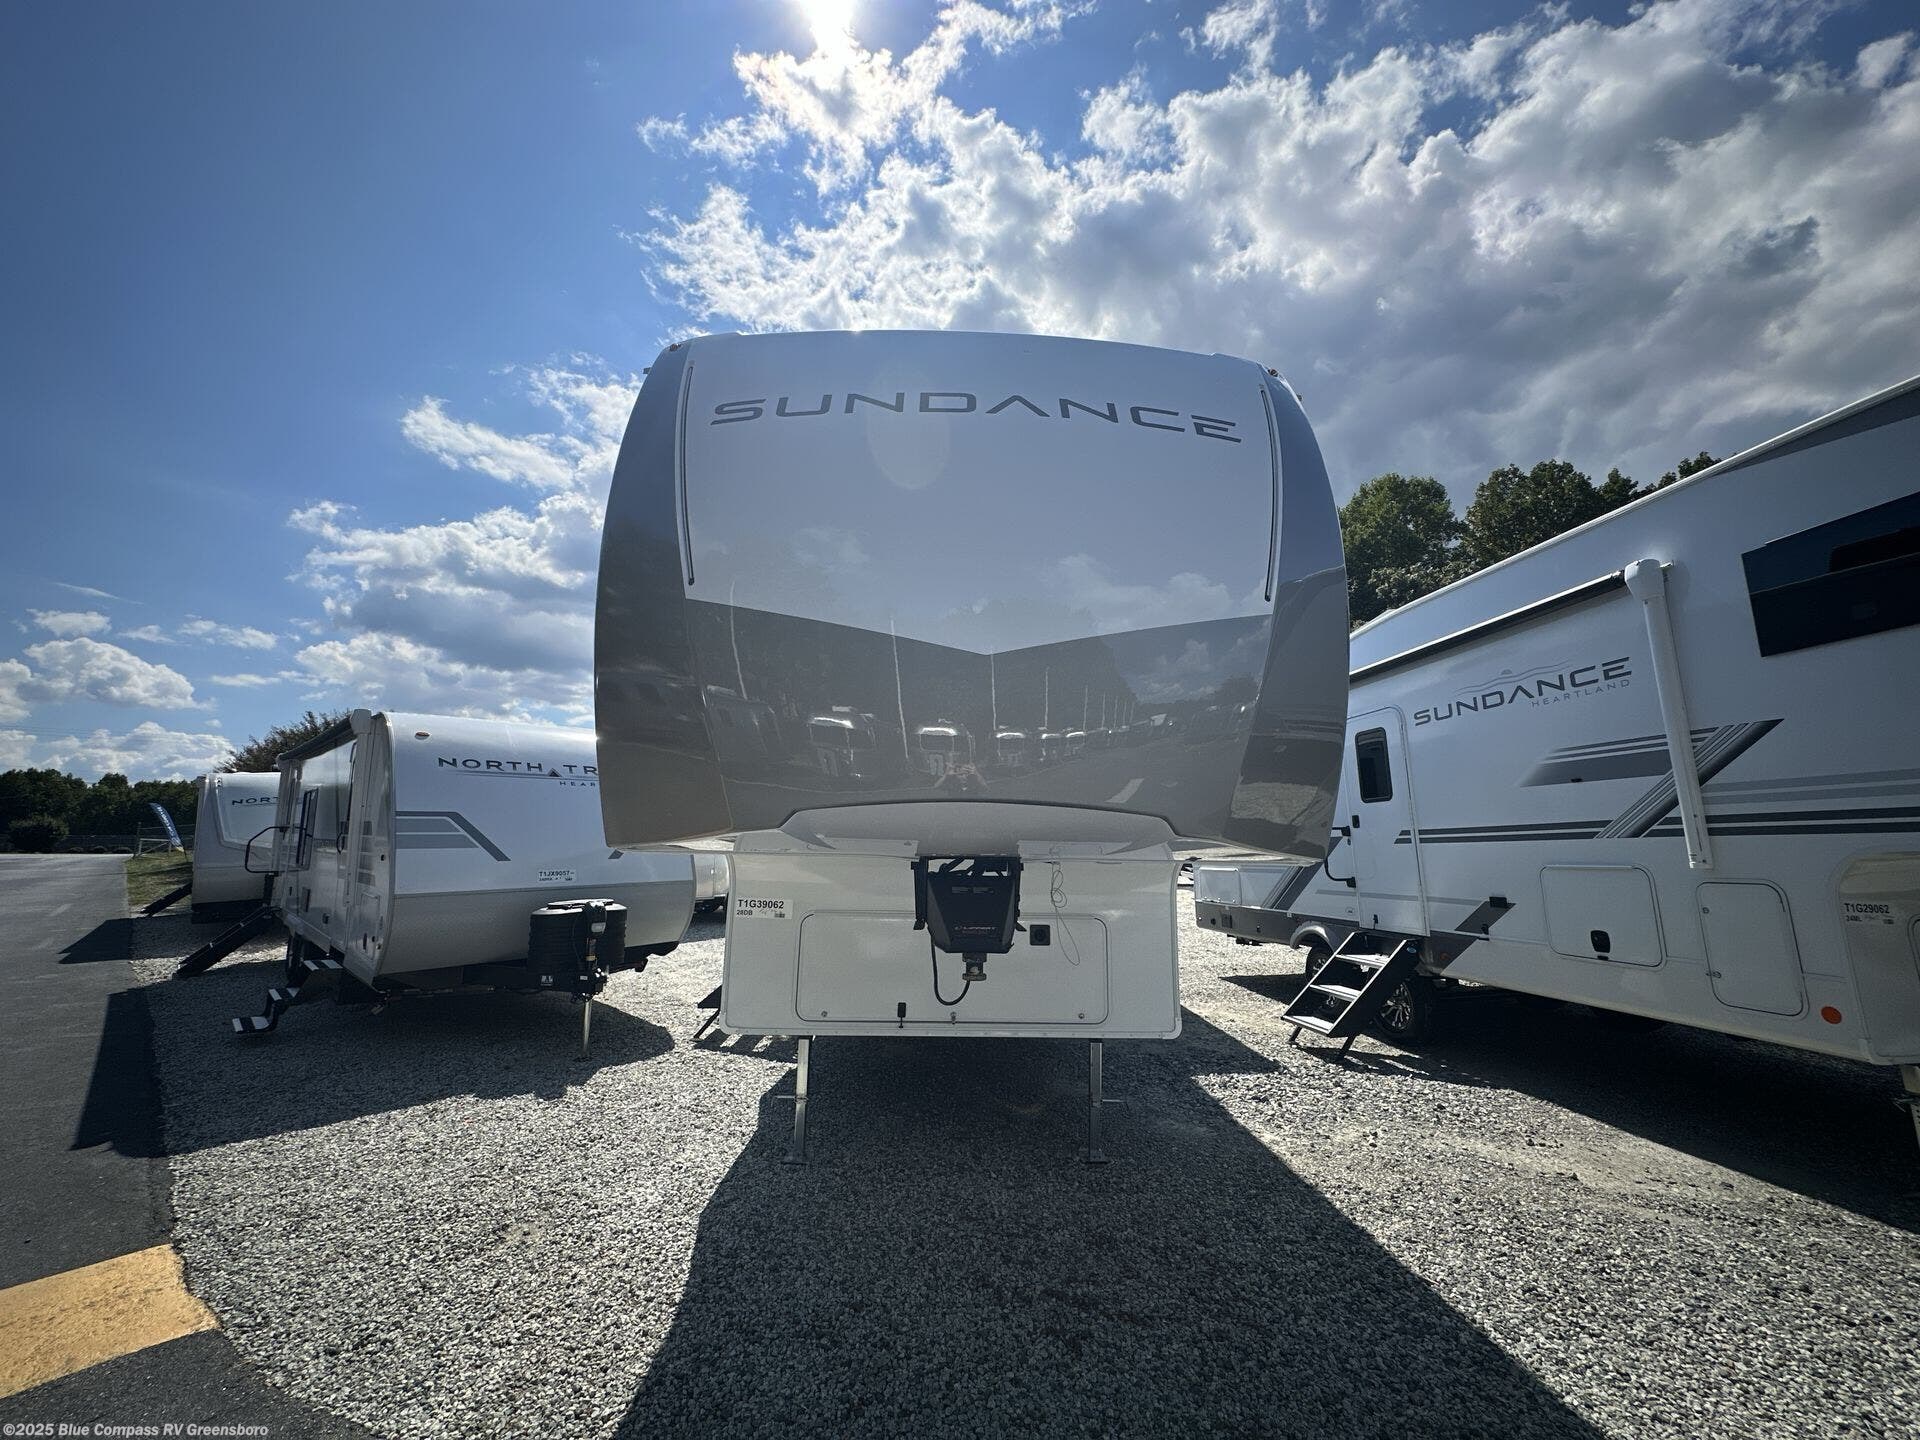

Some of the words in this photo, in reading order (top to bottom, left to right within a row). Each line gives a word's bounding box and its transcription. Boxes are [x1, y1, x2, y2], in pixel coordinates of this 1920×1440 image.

[710, 391, 1242, 443] SUNDANCE
[1413, 656, 1633, 727] SUNDANCE
[1531, 679, 1631, 709] HEARTLAND
[437, 757, 543, 773] NORTH
[737, 899, 785, 909] T1G39062
[1844, 902, 1890, 914] T1G29062
